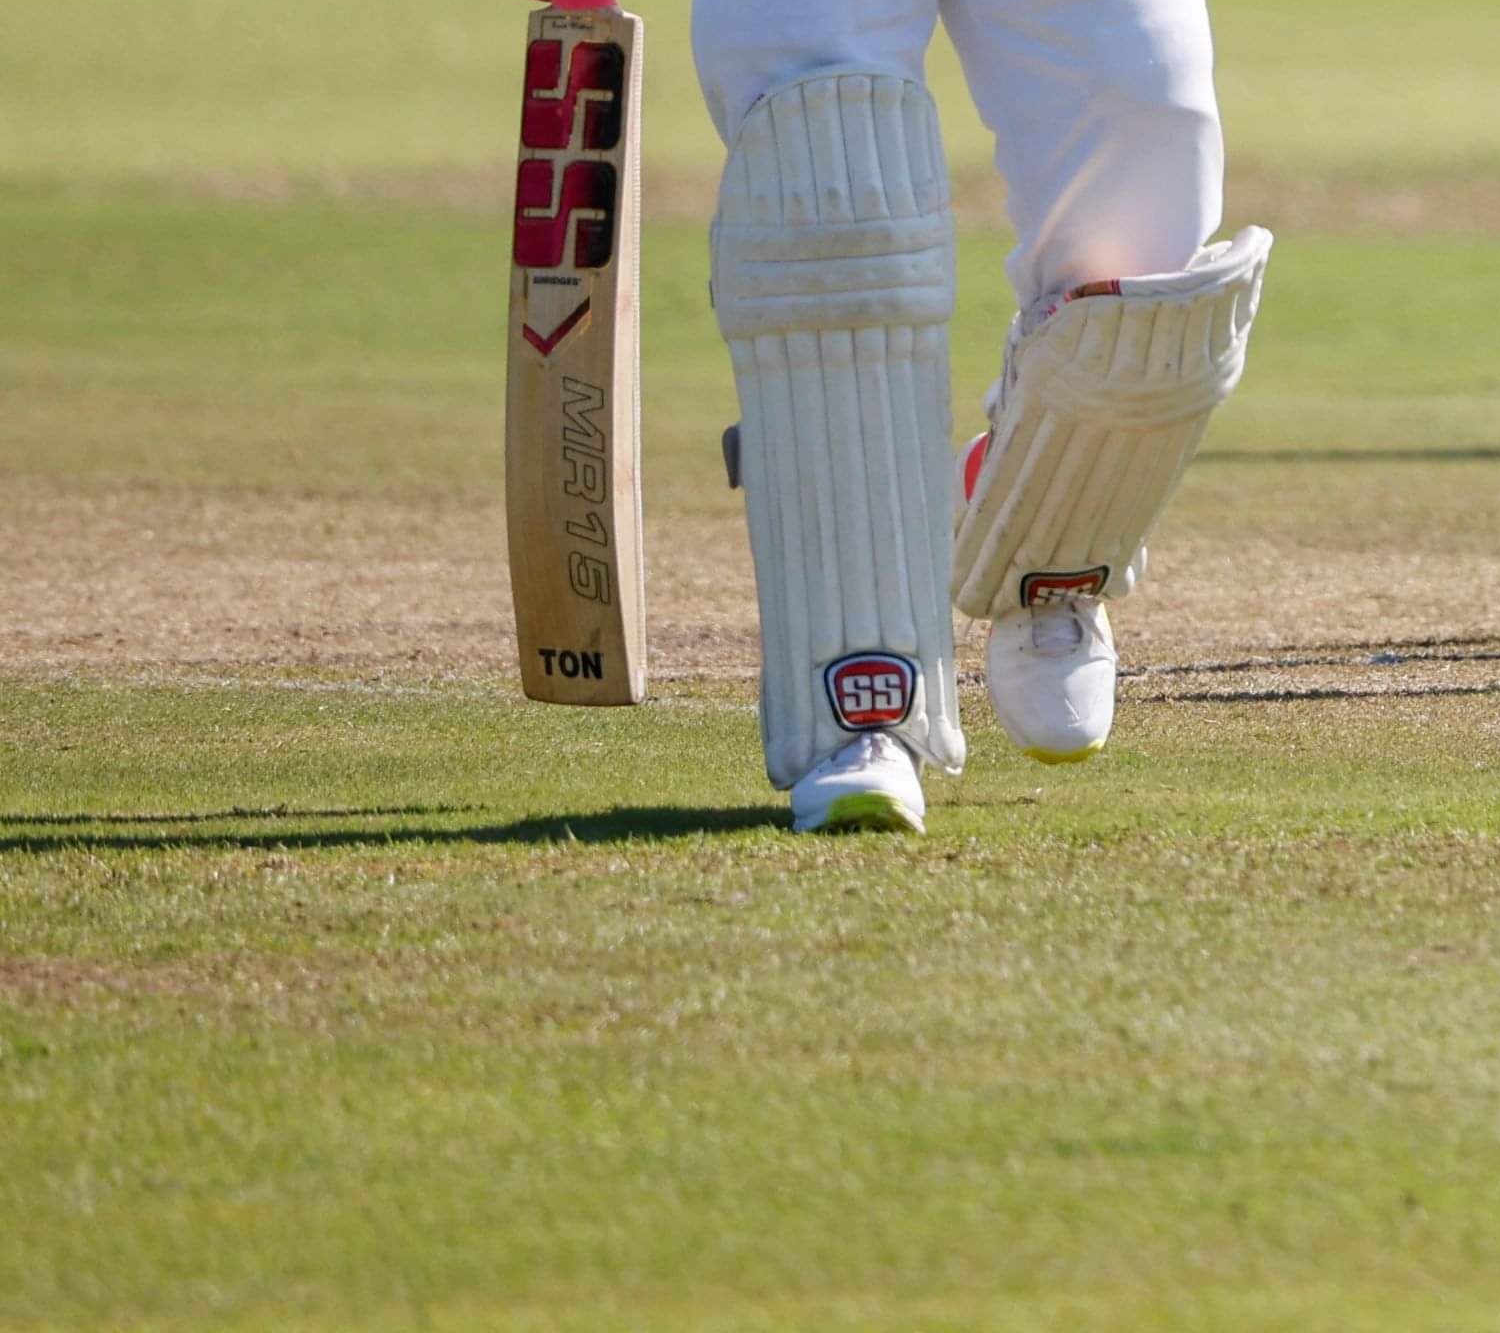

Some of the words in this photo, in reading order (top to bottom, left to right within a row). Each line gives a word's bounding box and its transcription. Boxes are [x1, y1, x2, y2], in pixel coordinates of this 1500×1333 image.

[562, 376, 611, 606] MR15
[538, 647, 604, 680] TON
[842, 673, 902, 712] SS
